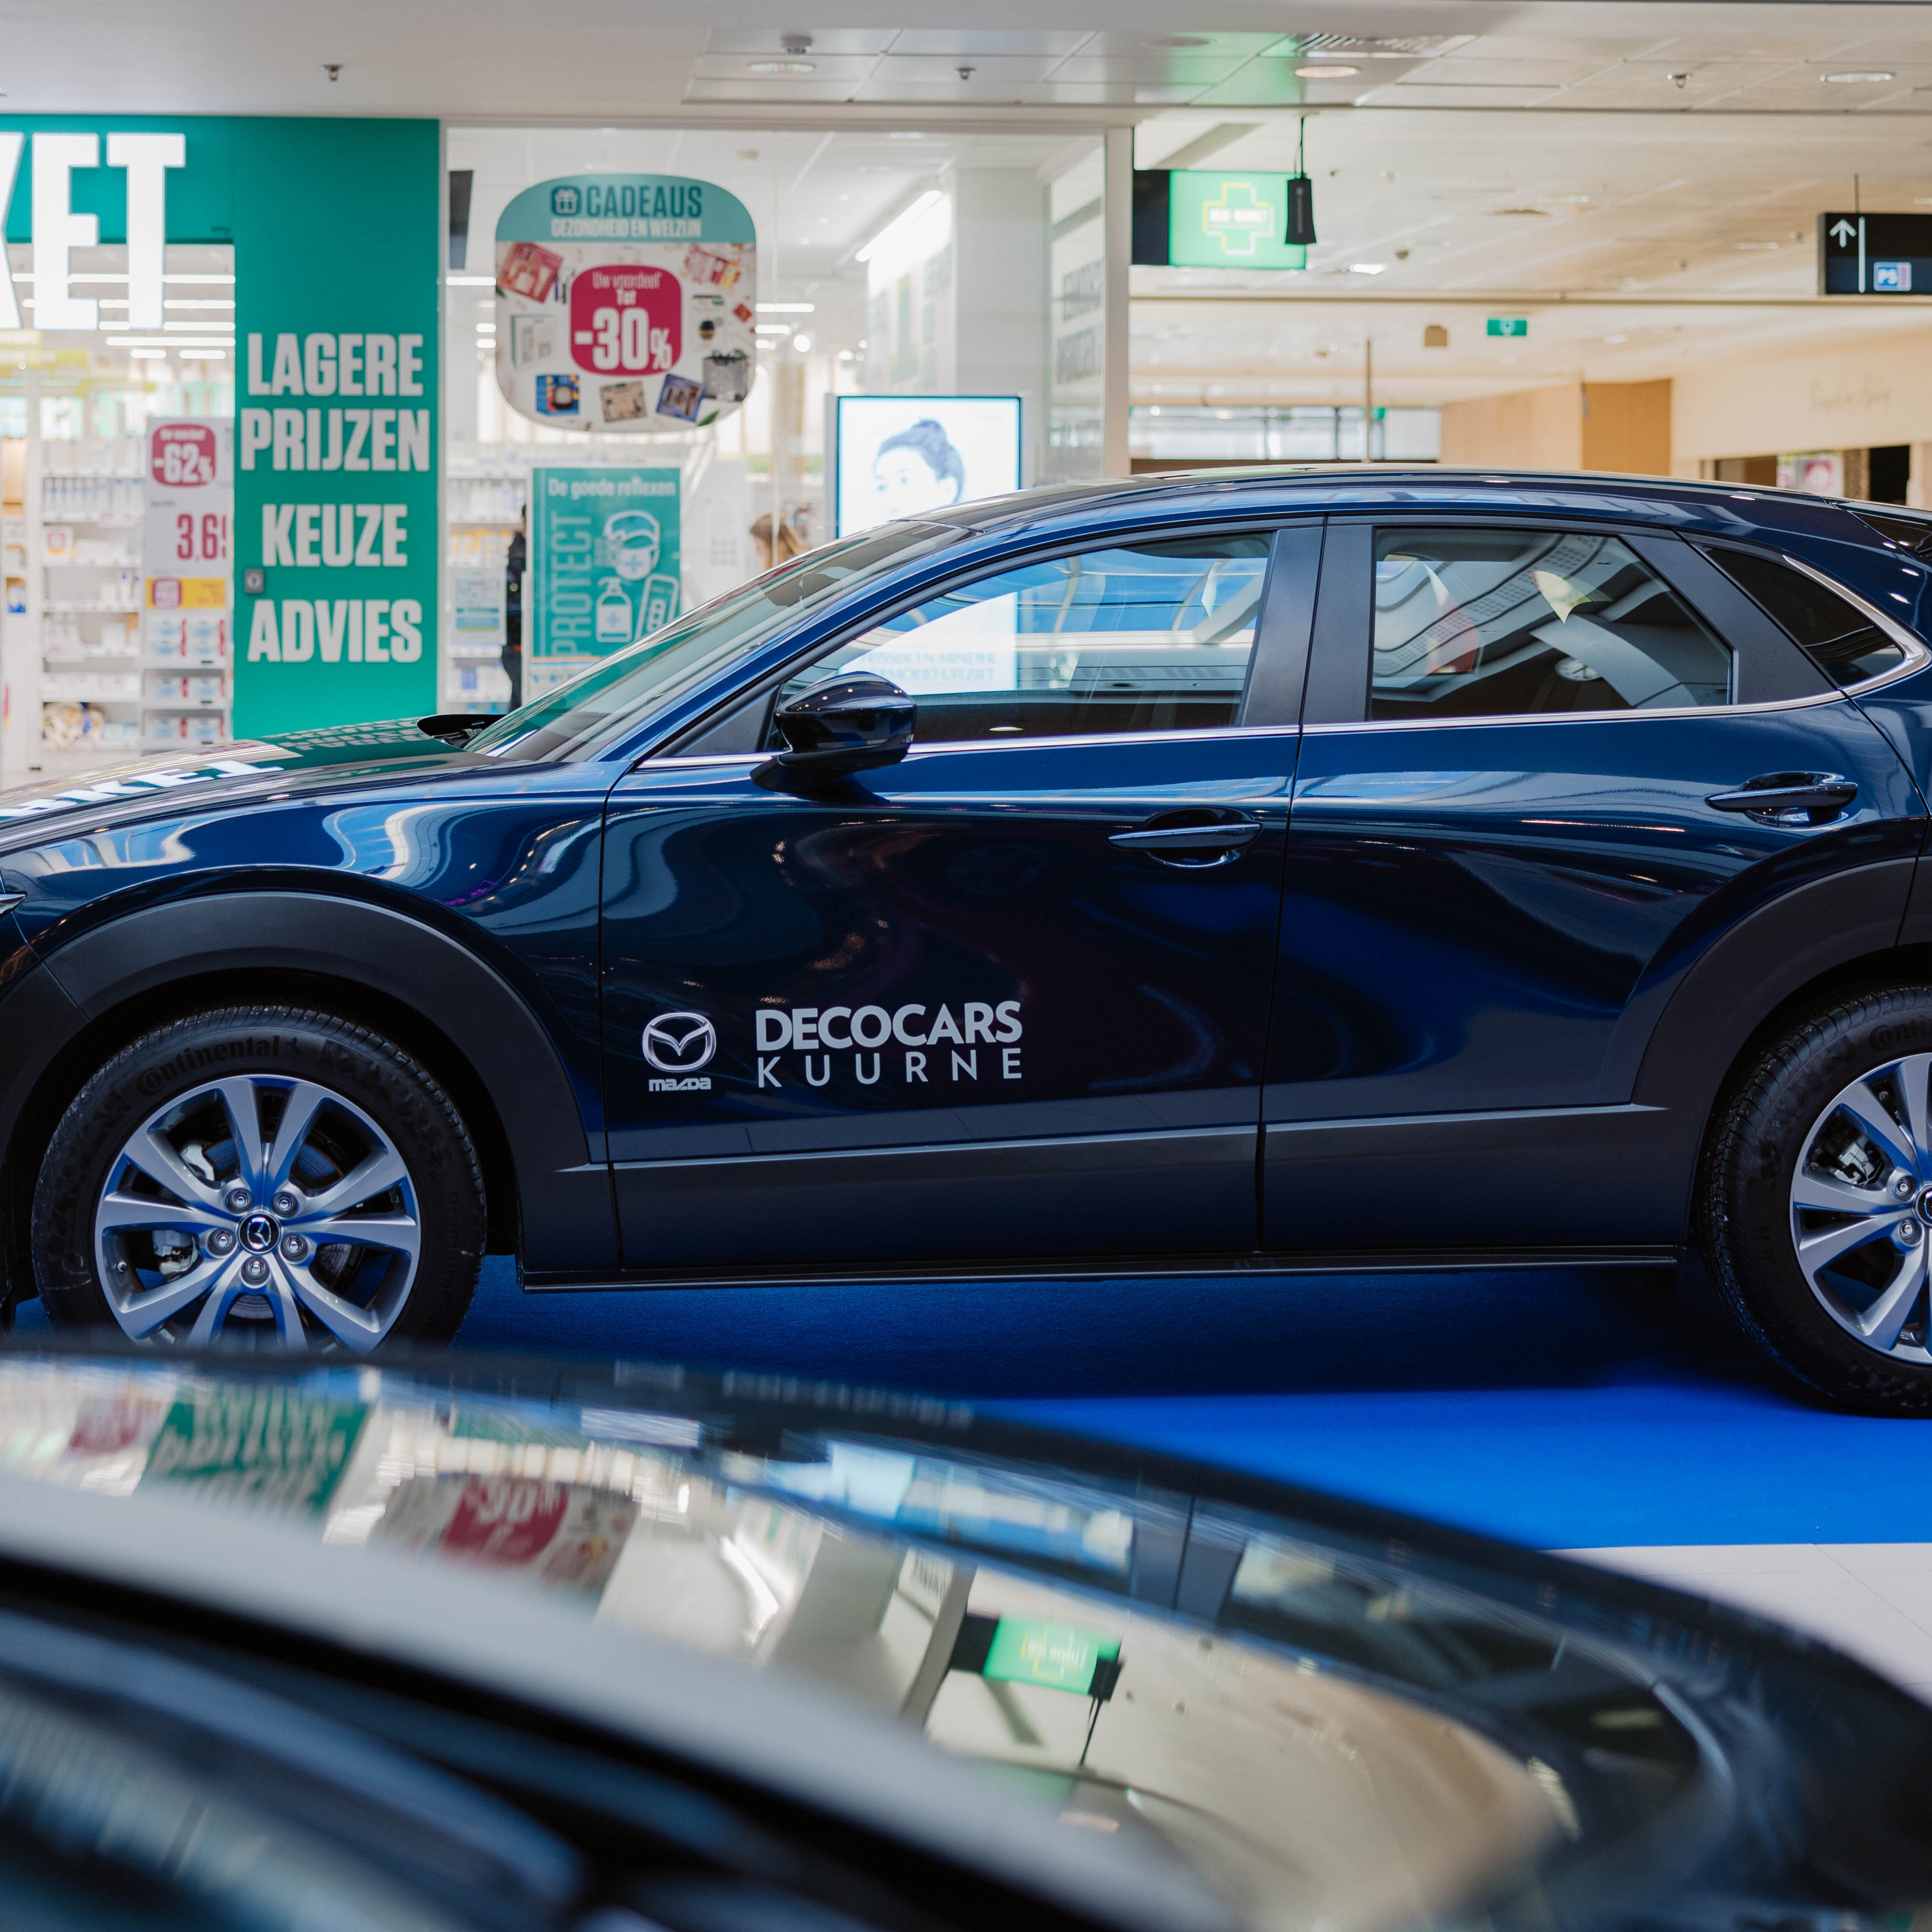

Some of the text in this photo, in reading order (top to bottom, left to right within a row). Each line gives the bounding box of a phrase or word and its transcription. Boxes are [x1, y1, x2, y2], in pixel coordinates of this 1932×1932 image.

[586, 185, 703, 218] CADEAUS
[551, 219, 702, 238] GEZONDHEID EN WELZIJN
[592, 271, 611, 289] Uw
[574, 306, 673, 370] -30%
[247, 333, 424, 397] LAGERE
[153, 442, 214, 483] -62%
[240, 408, 430, 472] PRIJZEN
[548, 478, 568, 497] De
[570, 480, 615, 500] goede
[261, 504, 408, 568] KEUZE
[551, 510, 593, 657] PROTECT
[246, 599, 423, 663] ADVIES
[756, 1001, 1023, 1051] DECOCARS
[136, 1035, 281, 1097] Continental
[649, 1077, 712, 1092] mazda
[758, 1048, 1023, 1089] KUURNE
